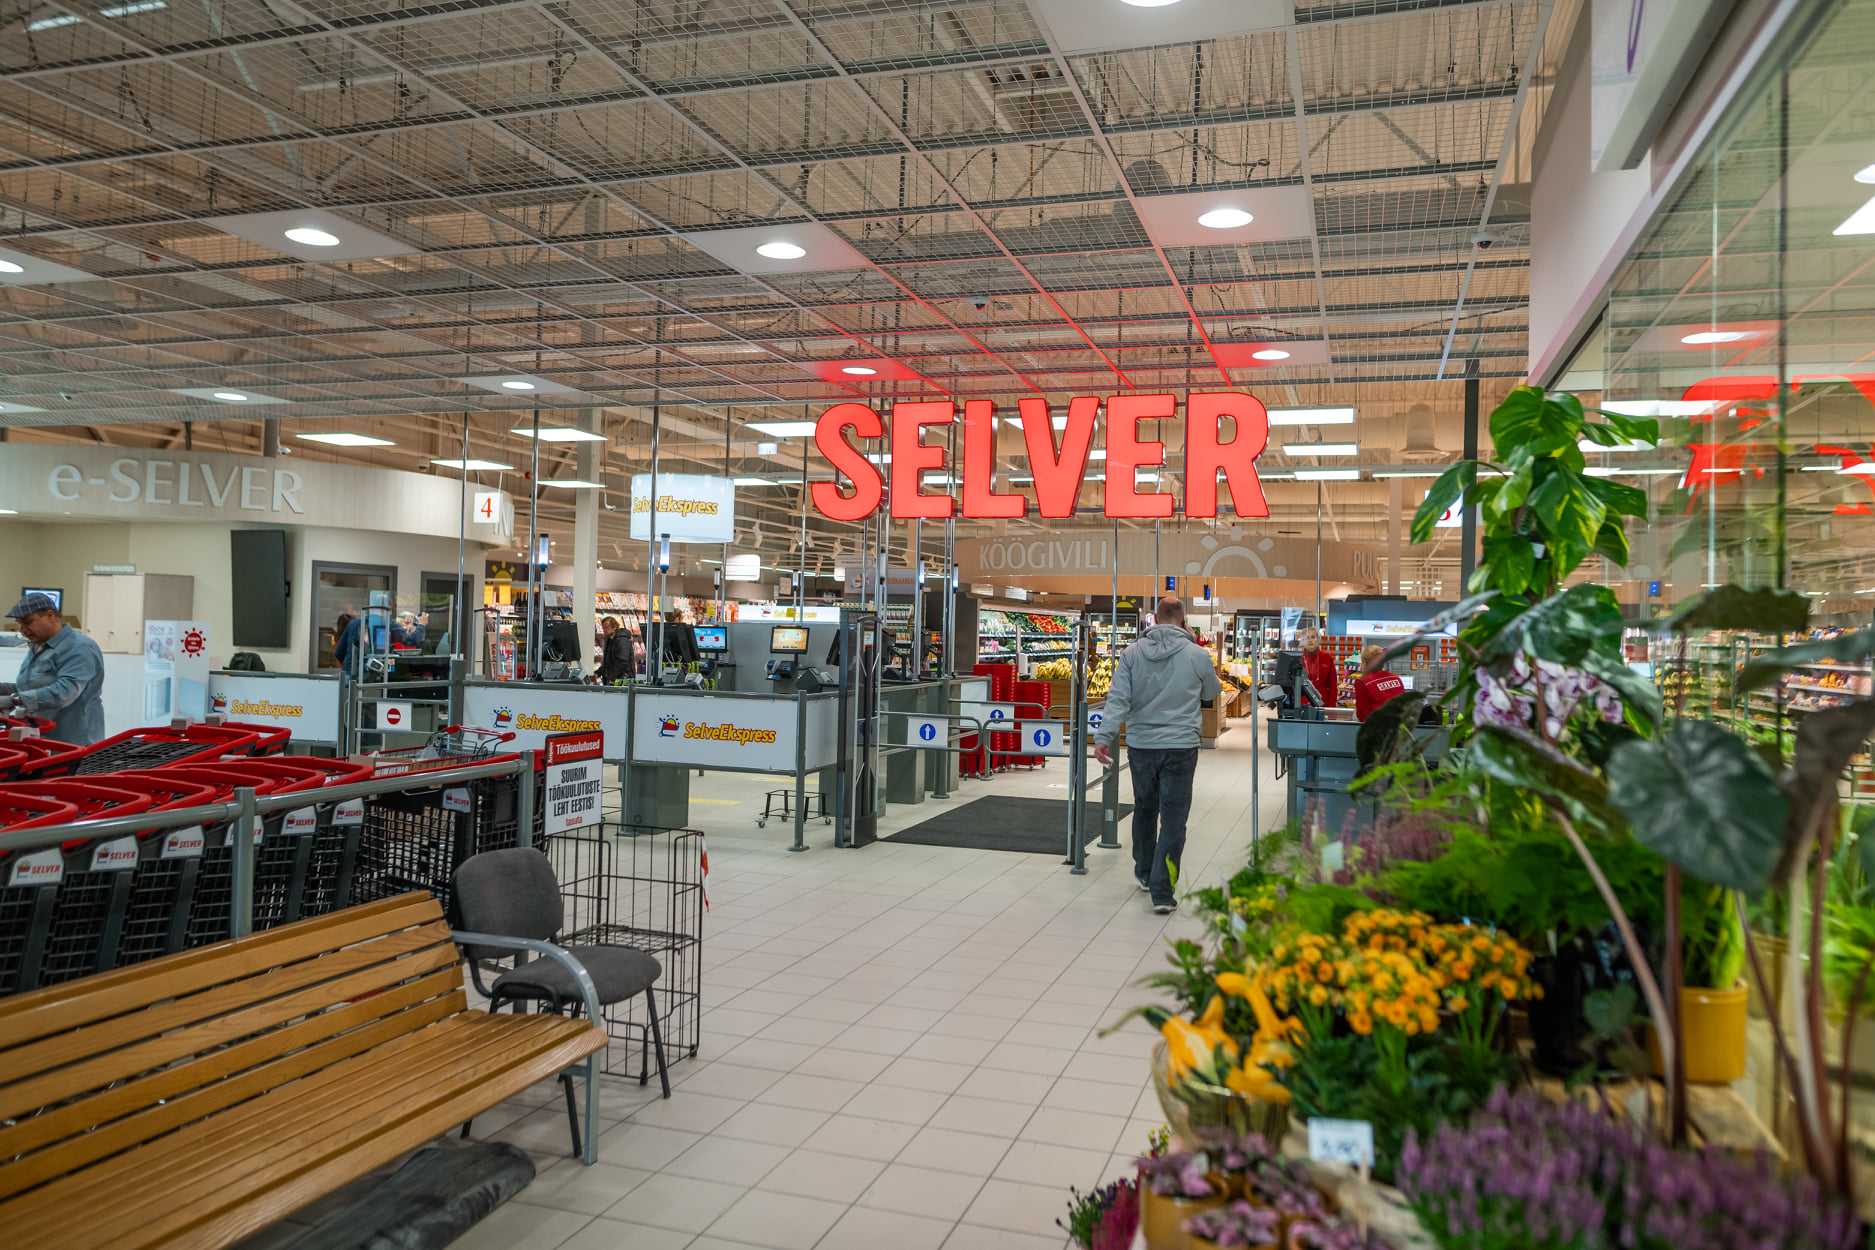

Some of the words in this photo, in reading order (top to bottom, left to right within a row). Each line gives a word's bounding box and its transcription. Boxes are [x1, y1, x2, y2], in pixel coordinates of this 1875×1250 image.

[810, 392, 1272, 522] SELVER
[49, 458, 304, 515] e-SELVER
[480, 497, 493, 519] 4
[633, 495, 719, 518] SelvEkspress
[979, 537, 1108, 570] KÖÖGIVILI
[230, 699, 304, 720] SelveEkspress
[516, 713, 601, 733] SelveEkspress
[683, 721, 777, 747] SelveEkspress
[556, 739, 600, 755] Töökuulutused
[561, 766, 587, 784] SUURIM
[548, 779, 600, 802] TÖÖKUULUTUSTE
[553, 800, 569, 817] LEHT
[571, 796, 595, 812] EESTIS!
[565, 816, 583, 827] tasuta
[179, 840, 202, 848] SELVER
[109, 851, 136, 860] SELVER
[31, 864, 61, 875] SELVER
